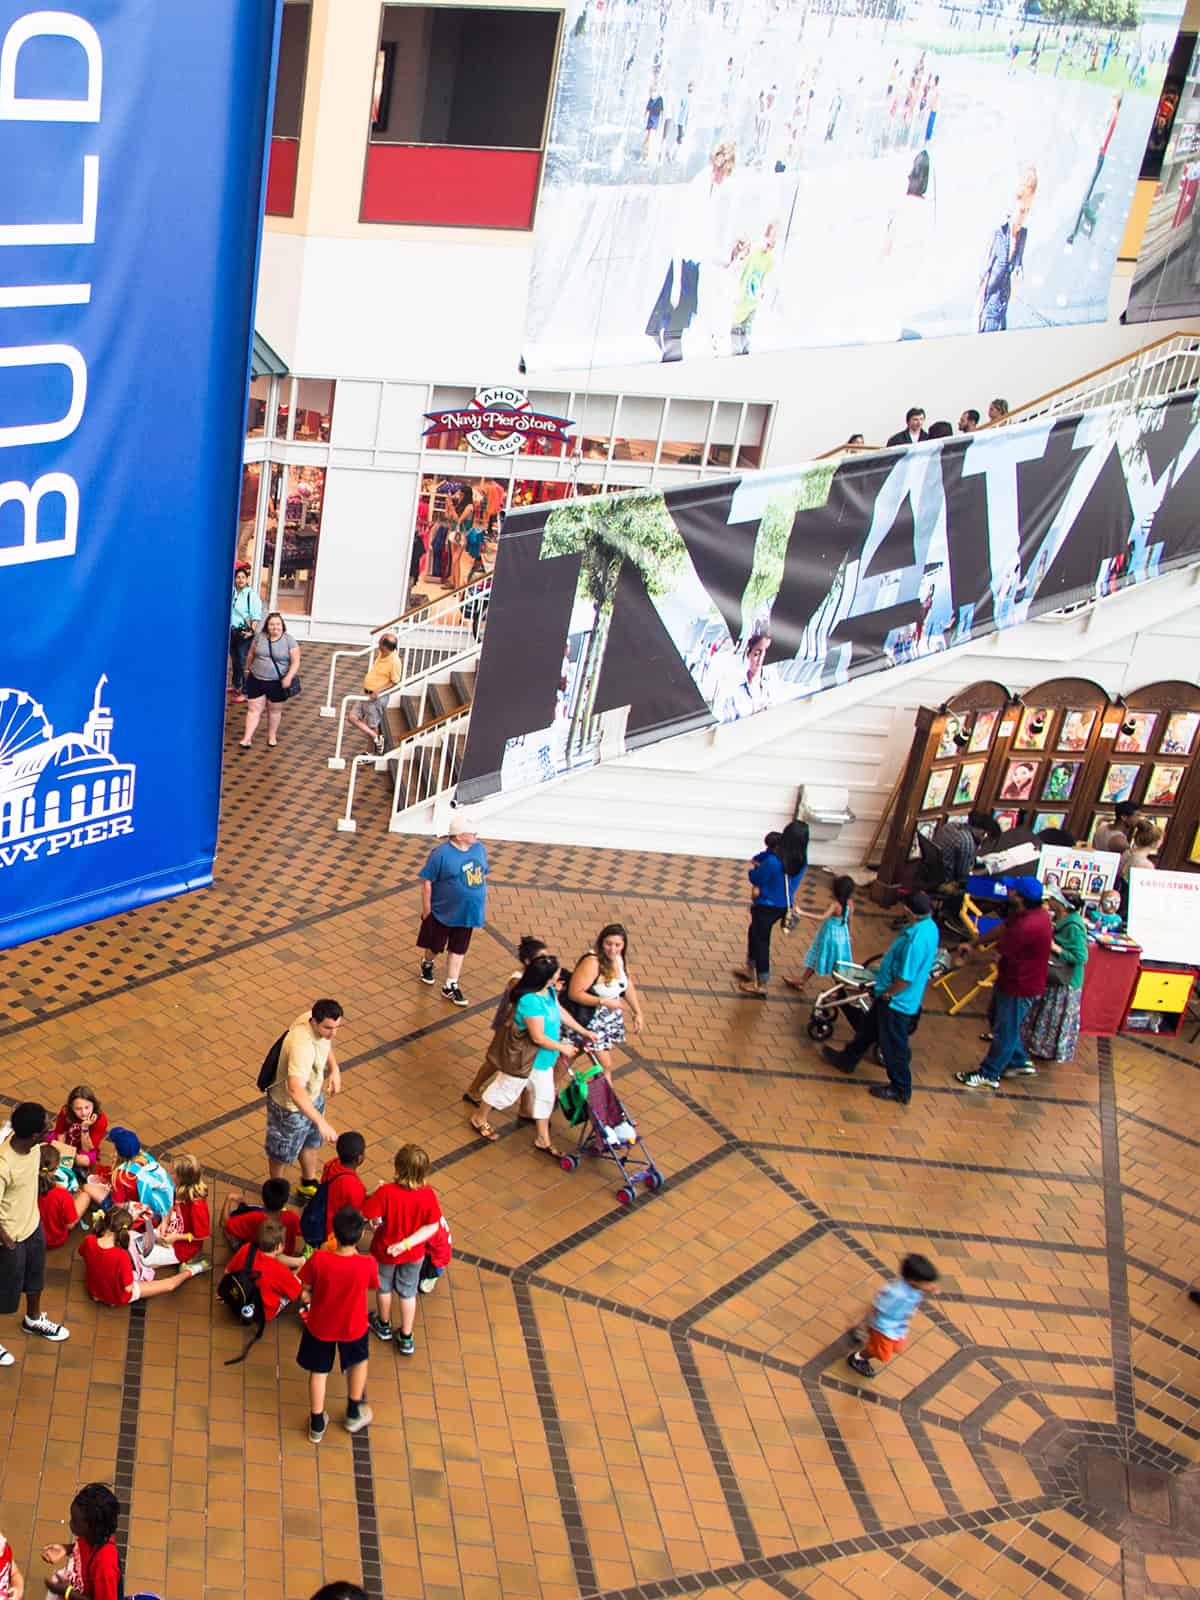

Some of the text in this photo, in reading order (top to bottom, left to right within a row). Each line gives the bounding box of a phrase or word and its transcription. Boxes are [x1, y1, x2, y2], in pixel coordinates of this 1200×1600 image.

[484, 391, 522, 405] AHOY
[441, 412, 556, 432] Navy Pier Store
[471, 433, 521, 451] CHICAGO
[46, 814, 135, 857] PIER
